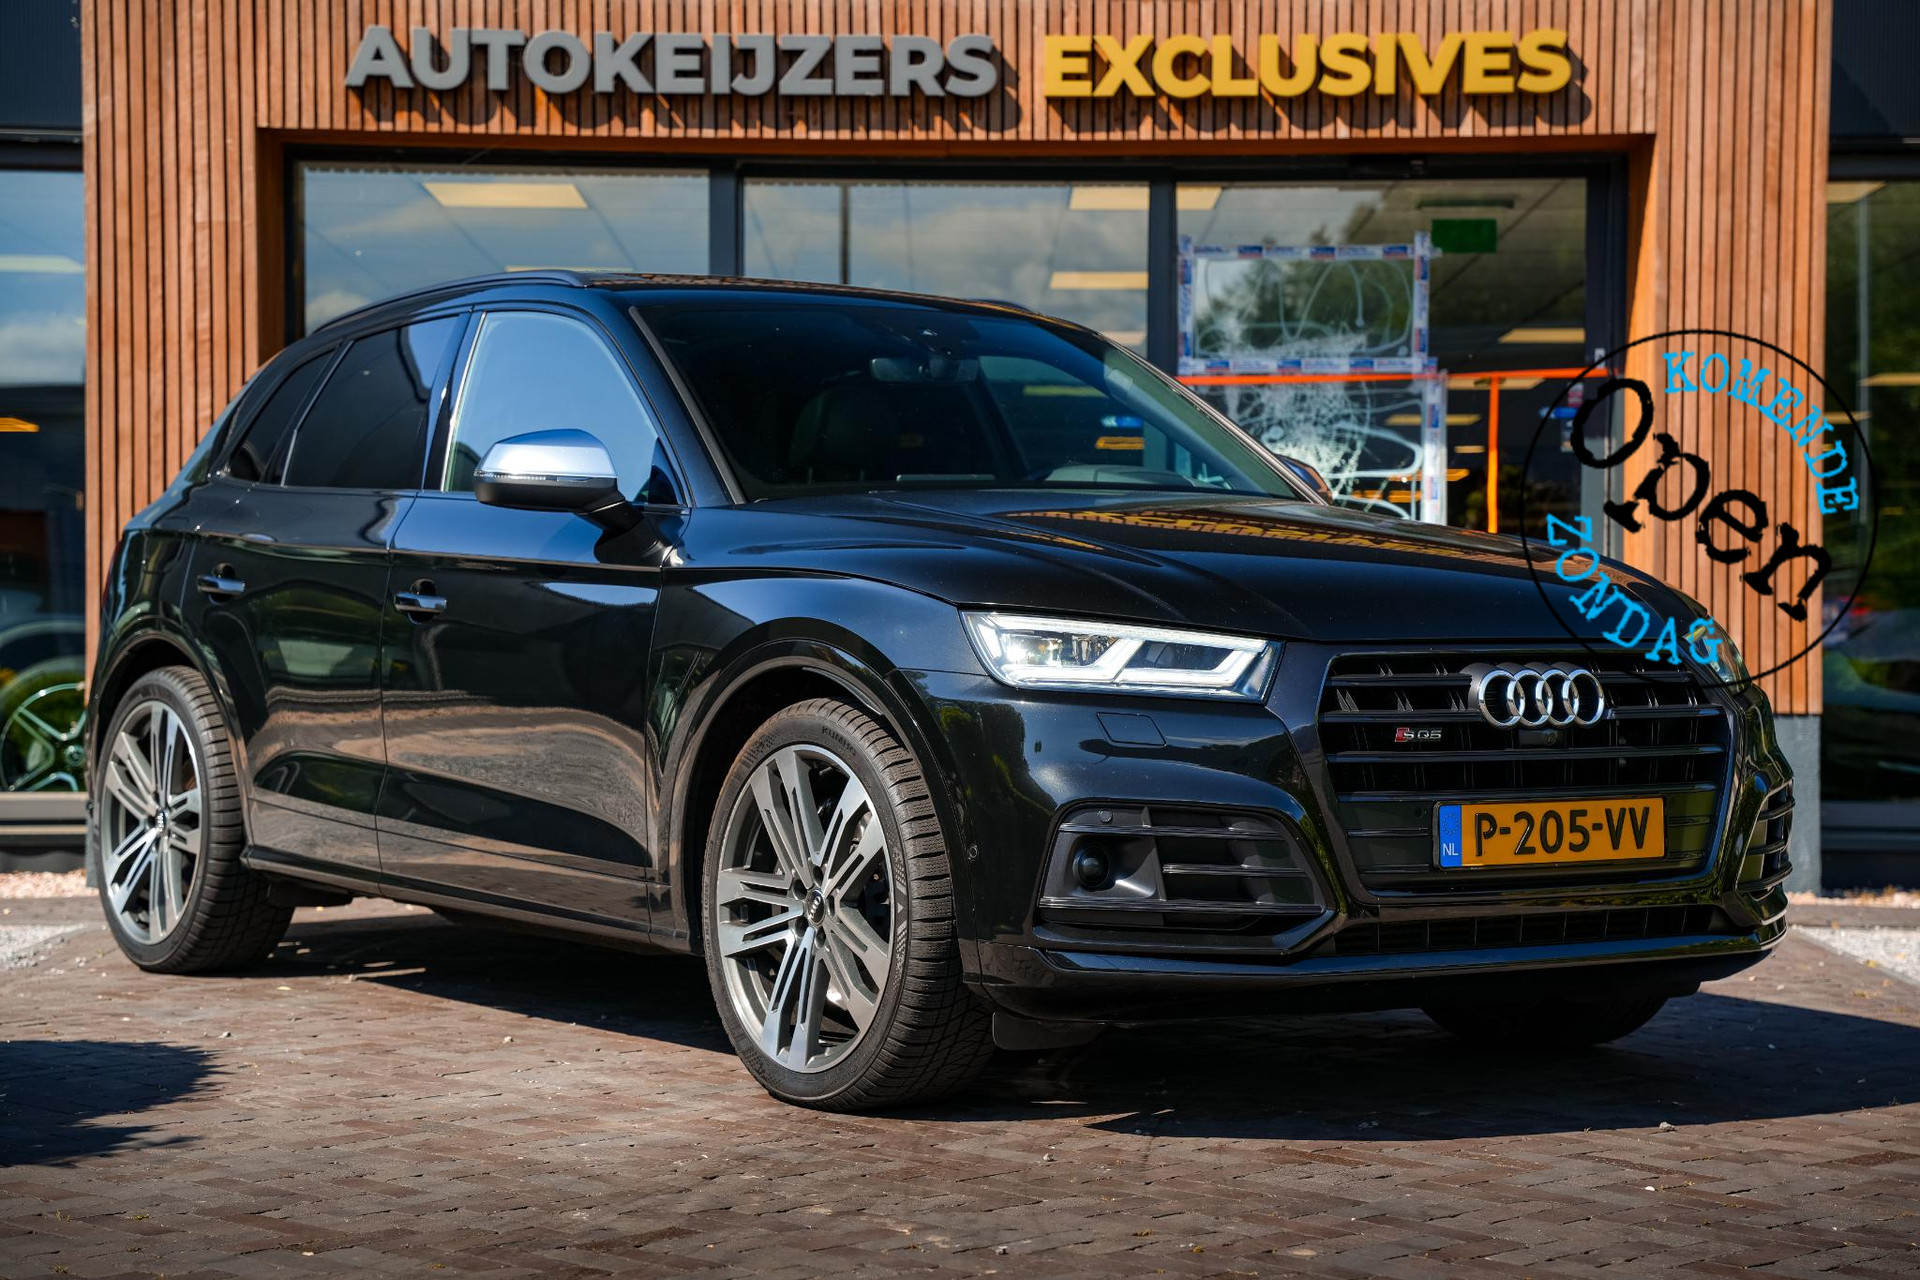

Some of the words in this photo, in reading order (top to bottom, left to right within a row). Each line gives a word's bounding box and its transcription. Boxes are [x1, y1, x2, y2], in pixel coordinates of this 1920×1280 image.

[345, 24, 998, 97] AUTOKEIJZERS
[1043, 29, 1572, 98] EXCLUSIVES
[1400, 729, 1442, 741] SQ5
[1474, 806, 1650, 857] P-205-VV
[1442, 842, 1459, 856] NL
